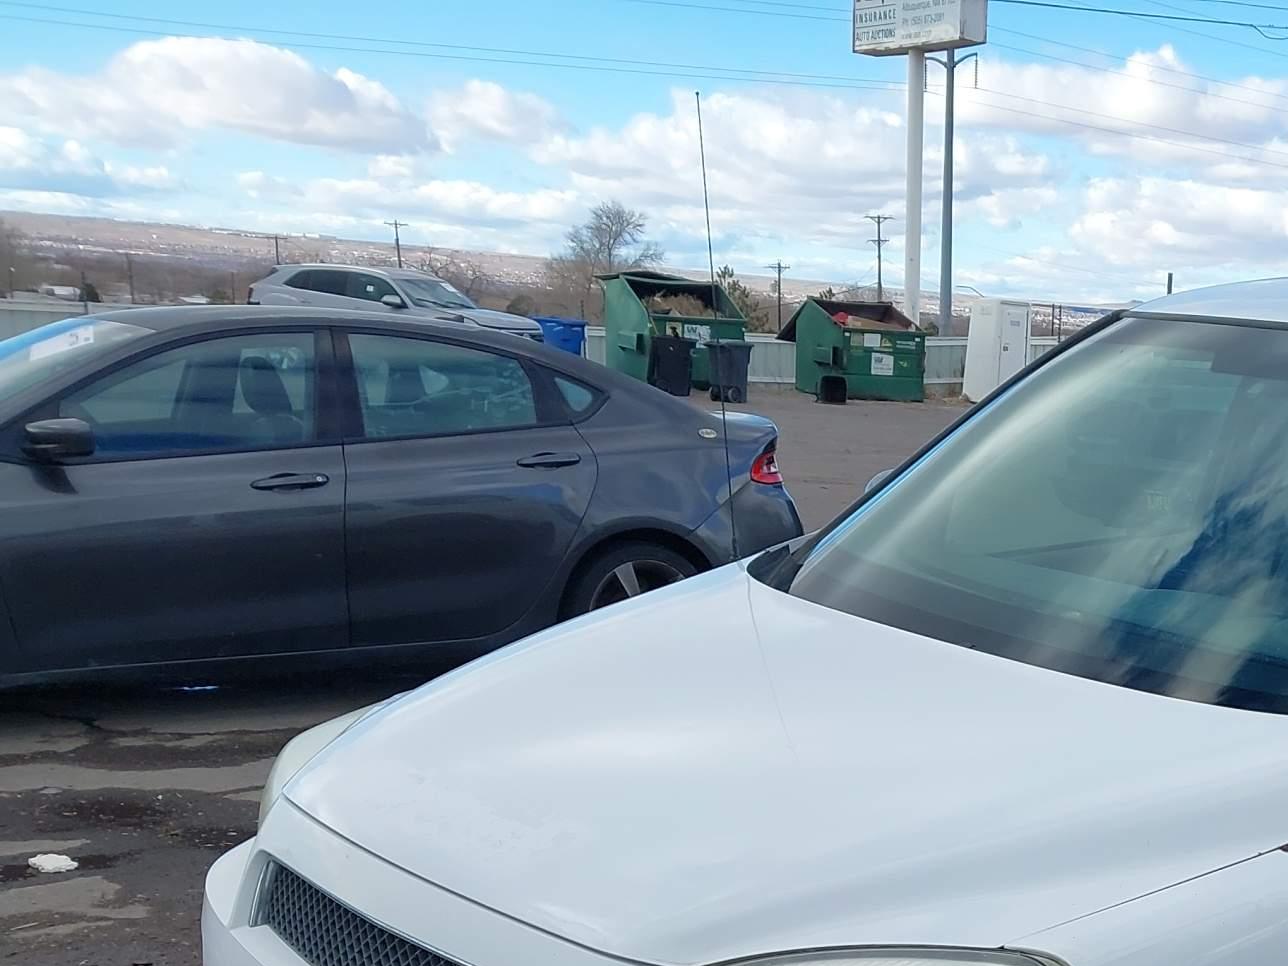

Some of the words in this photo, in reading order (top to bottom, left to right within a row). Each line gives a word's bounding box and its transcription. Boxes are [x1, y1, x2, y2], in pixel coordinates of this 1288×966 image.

[856, 9, 896, 24] INSURANCE
[856, 29, 870, 42] AUTO
[870, 28, 896, 40] AUCTIONS
